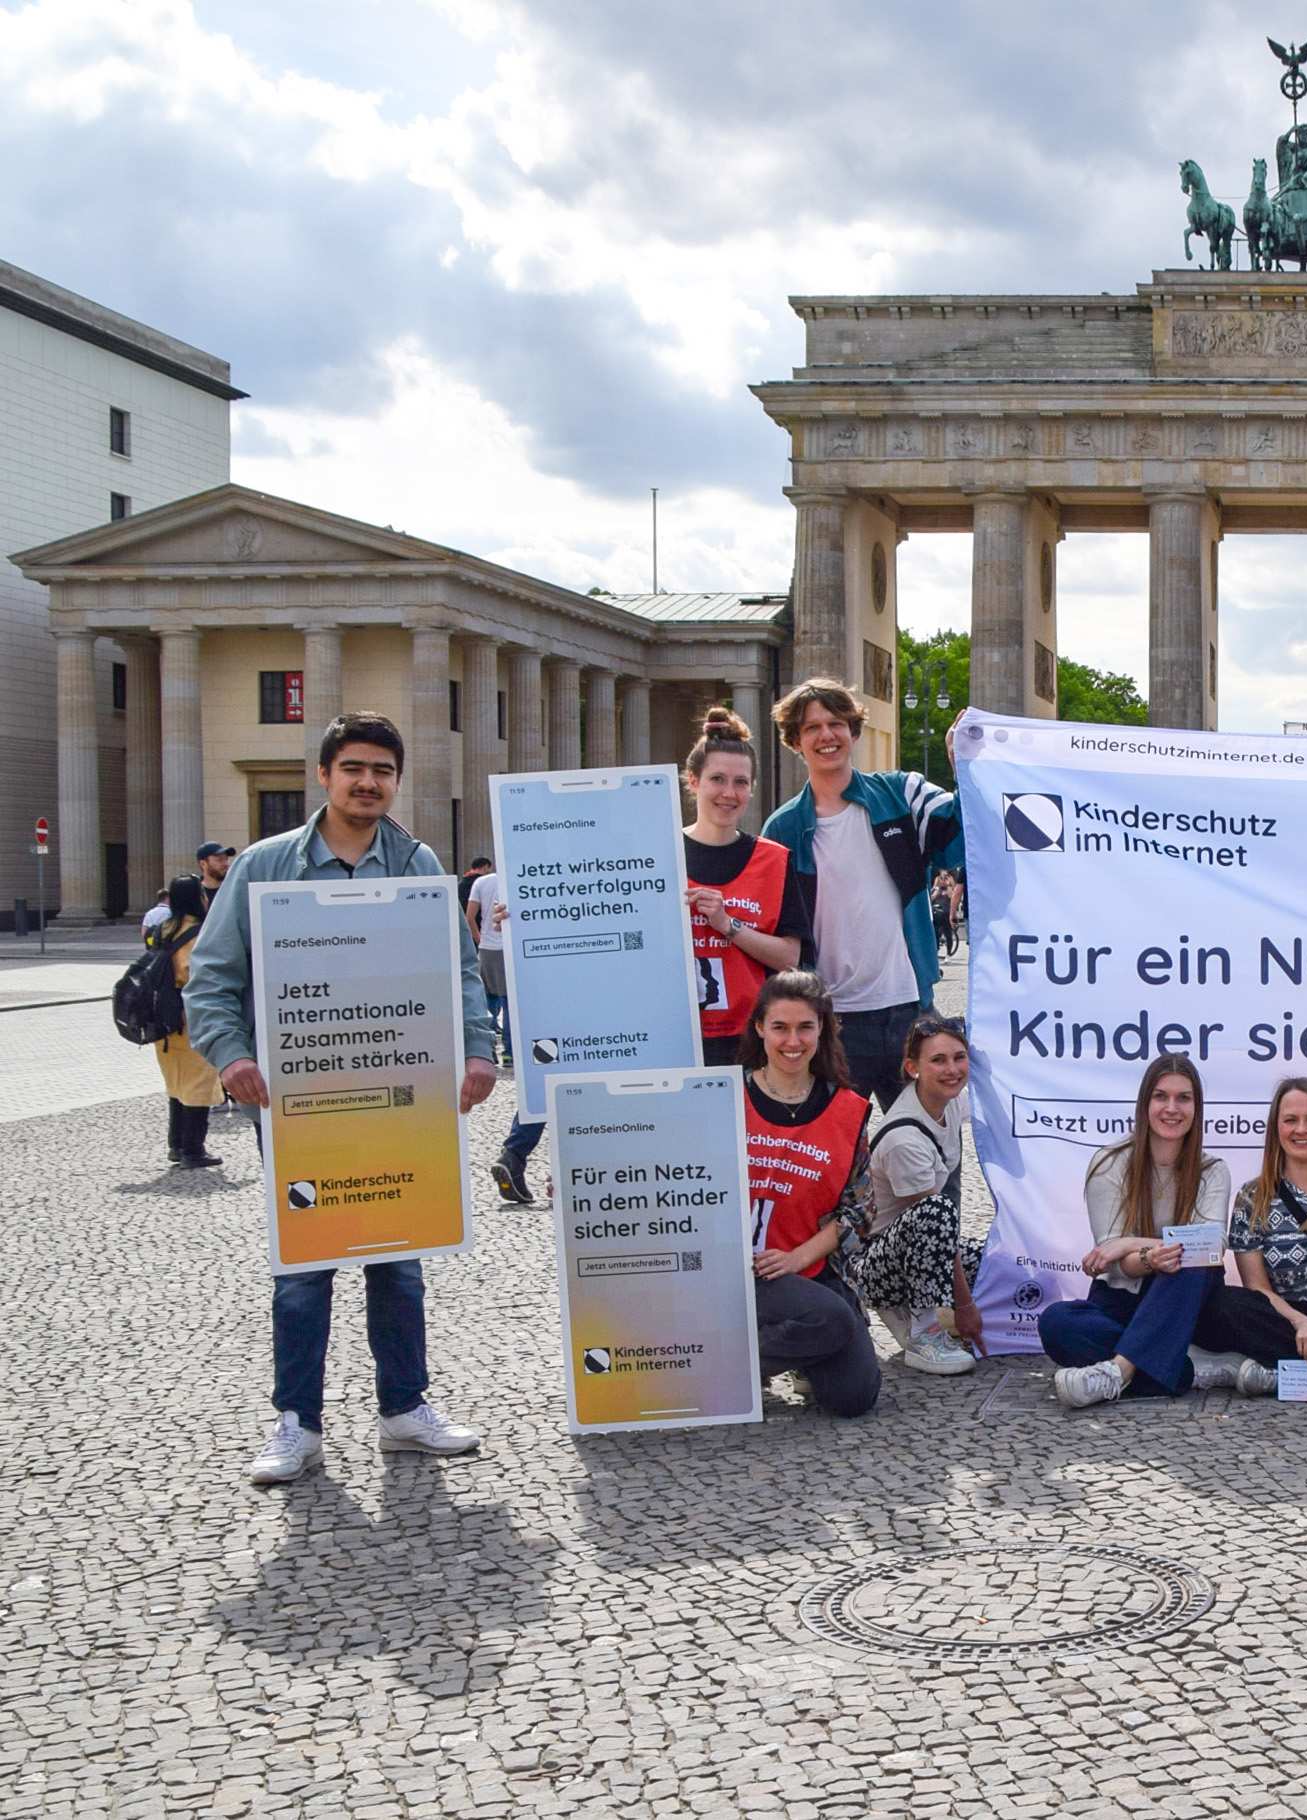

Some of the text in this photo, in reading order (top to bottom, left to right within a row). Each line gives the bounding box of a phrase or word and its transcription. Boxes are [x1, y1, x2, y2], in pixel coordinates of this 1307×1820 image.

[1071, 736, 1305, 765] kinderschutziminternet.de
[512, 819, 596, 832] #SafeSeinOnline
[1073, 800, 1278, 838] Kinderschutz
[1075, 828, 1248, 867] im Internet
[517, 856, 655, 878] Jetzt wirksame
[518, 877, 666, 900] Strafverfolgung
[520, 900, 639, 921] ermöglichen.
[274, 935, 367, 949] #SafeSeinOnline
[530, 938, 614, 952] Jetzt unterschreiben
[1009, 934, 1112, 985] Für
[1136, 935, 1231, 985] ein
[277, 981, 330, 1000] Jetzt
[278, 1000, 426, 1025] internationale
[280, 1028, 405, 1050] Zusammen-
[562, 1031, 649, 1049] Kinderschutz
[1010, 1010, 1224, 1061] Kinder
[281, 1050, 435, 1075] arbeit stärken.
[562, 1046, 638, 1063] im Internet
[290, 1094, 382, 1109] Jetzt unterschreiben
[568, 1122, 655, 1136] #SafeSeinOnline
[1026, 1110, 1087, 1134] Jetzt
[321, 1171, 414, 1191] Kinderschutz
[571, 1163, 712, 1186] Für ein Netz,
[322, 1187, 402, 1207] im Internet
[572, 1188, 728, 1213] in dem Kinder
[574, 1216, 698, 1240] sicher sind.
[585, 1258, 671, 1271] Jetzt unterschreiben
[1040, 1258, 1082, 1272] Initiativ
[614, 1343, 704, 1358] Kinderschutz
[615, 1357, 691, 1372] im Internet
